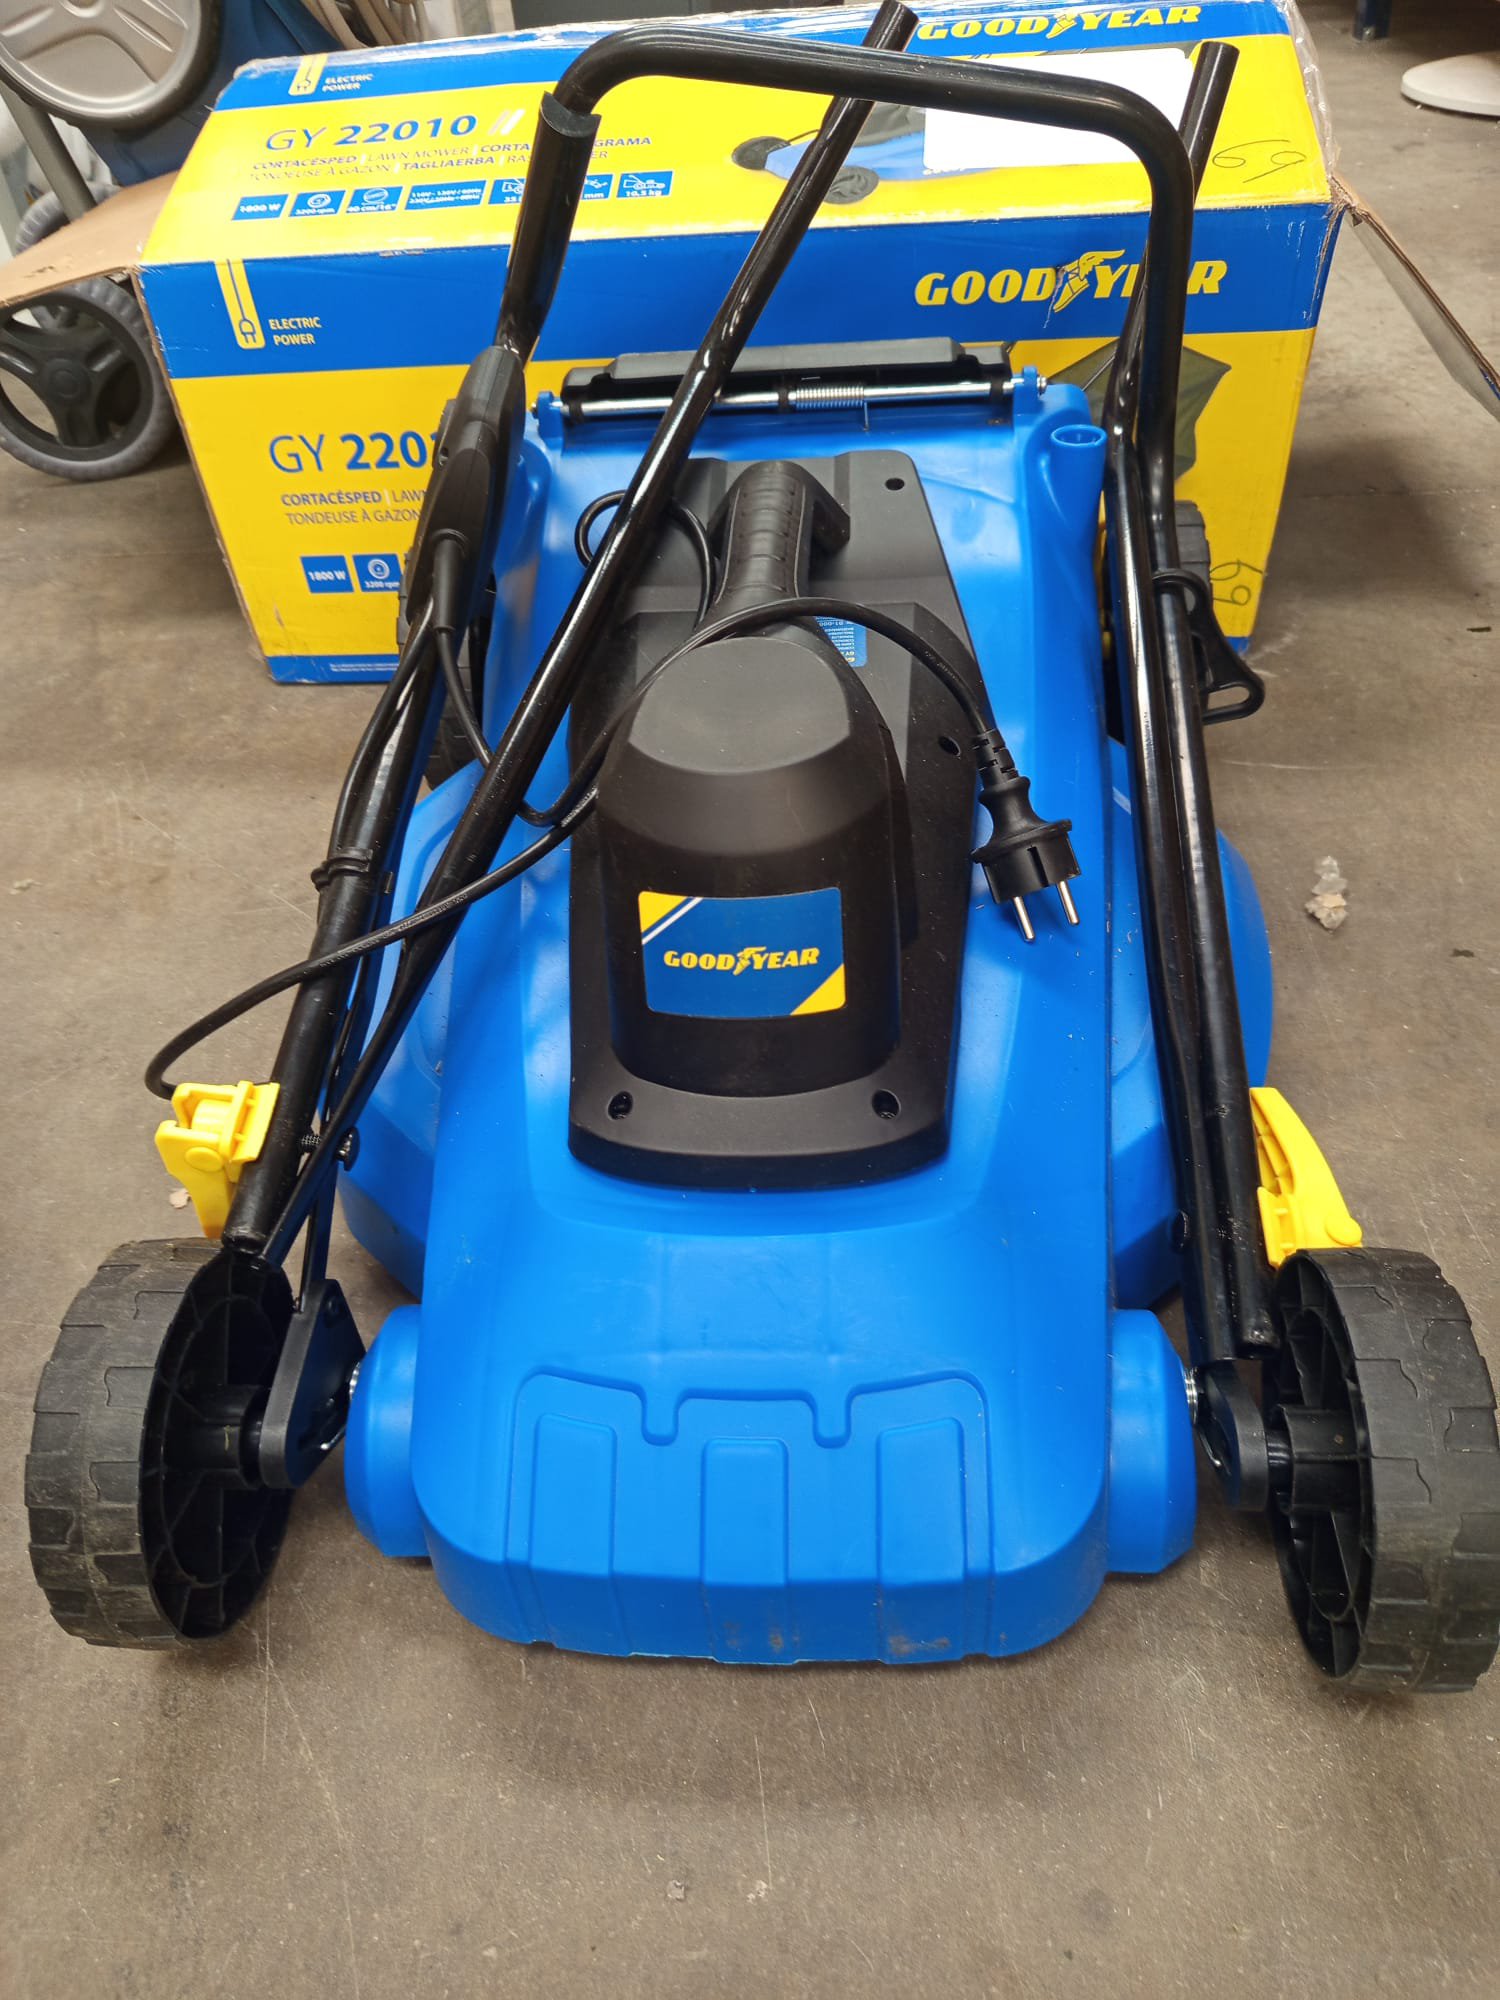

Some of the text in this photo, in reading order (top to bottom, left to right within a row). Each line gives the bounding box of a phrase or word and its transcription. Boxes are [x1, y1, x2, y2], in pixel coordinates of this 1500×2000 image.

[917, 5, 1202, 40] GOODYEAR
[324, 73, 373, 85] ELECTRIC
[321, 82, 361, 92] POWER
[266, 114, 477, 151] GY 22010
[403, 156, 495, 171] TAGLIAERBA
[1212, 139, 1307, 184] 69
[648, 188, 662, 197] kg
[268, 317, 322, 330] ELECTRIC
[273, 333, 316, 346] POWER
[269, 434, 325, 474] GY
[281, 489, 382, 507] CORTACÉSPED
[286, 510, 357, 526] TONDEUSE
[308, 570, 346, 582] 1800 W
[663, 946, 819, 976] GOODYEAR
